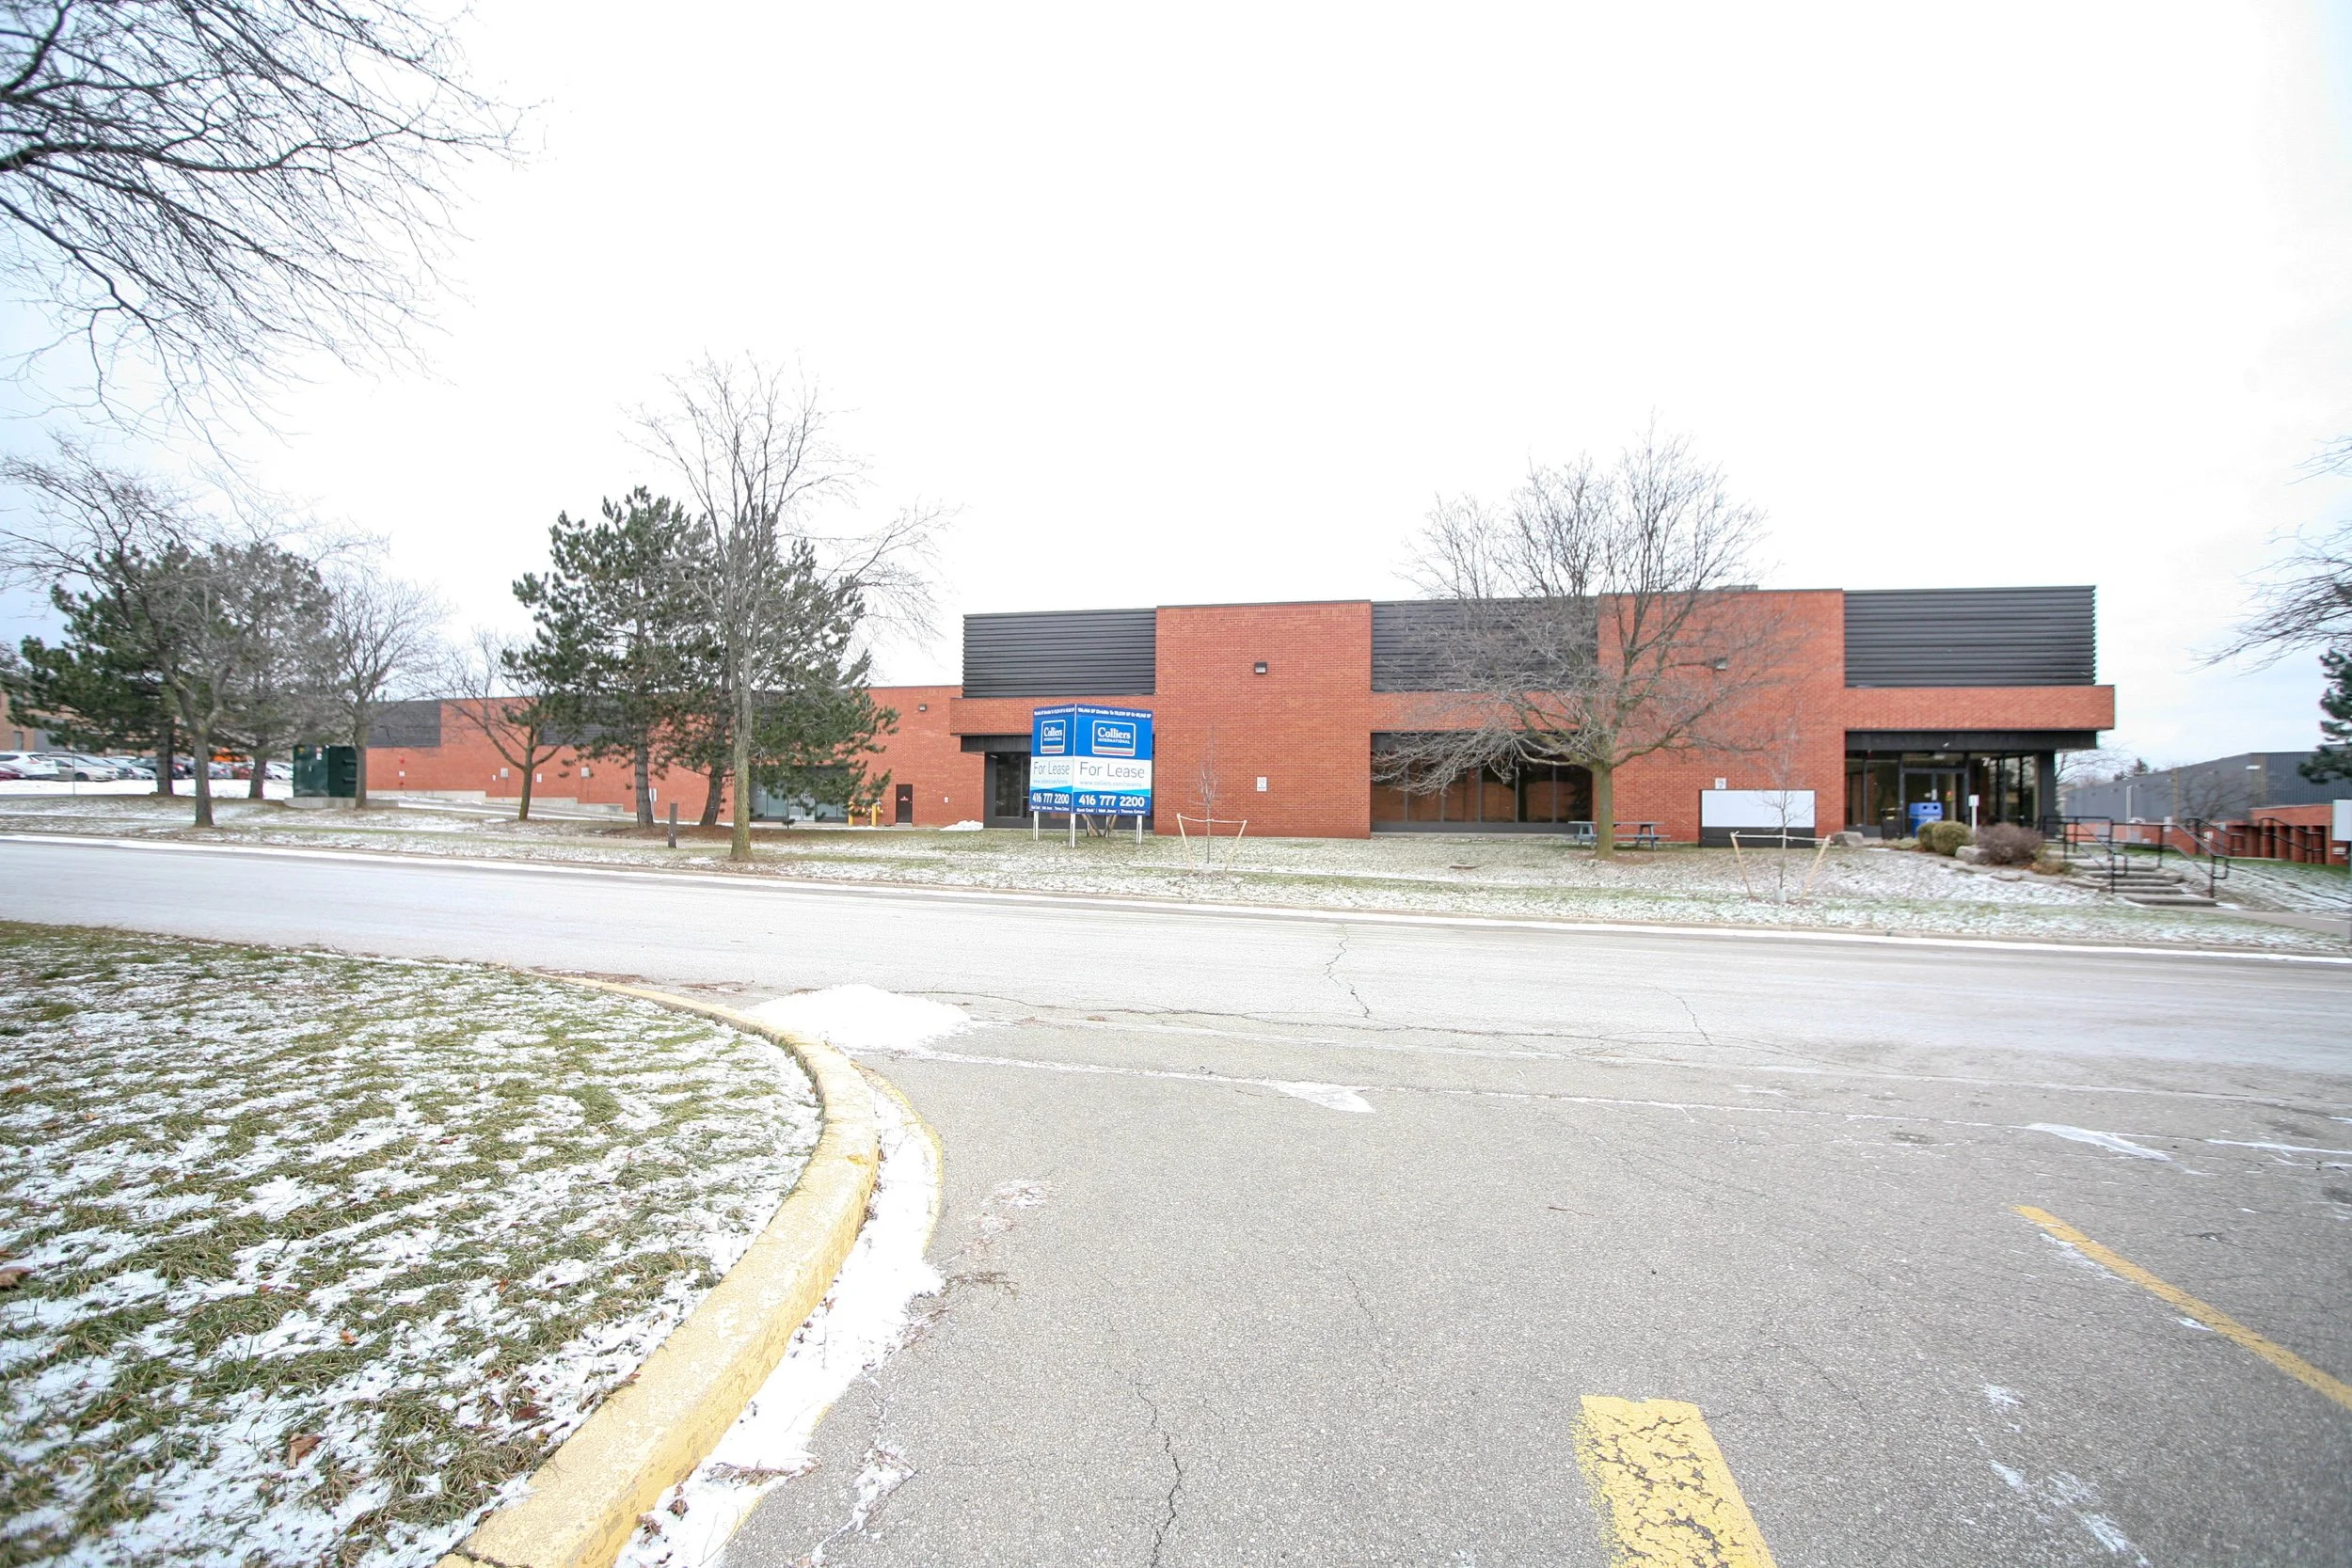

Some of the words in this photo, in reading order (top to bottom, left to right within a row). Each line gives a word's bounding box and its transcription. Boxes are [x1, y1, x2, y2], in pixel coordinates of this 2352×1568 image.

[1043, 727, 1062, 737] Colliers
[1097, 727, 1131, 739] Colliers
[1033, 761, 1046, 775] For
[1048, 761, 1071, 775] Lease
[1080, 761, 1104, 776] For
[1107, 763, 1145, 779] Lease
[1033, 793, 1042, 803] 416
[1043, 793, 1053, 804] 777
[1054, 794, 1070, 805] 2200
[1079, 795, 1096, 805] 416
[1099, 796, 1117, 806] 777
[1120, 797, 1145, 807] 2200
